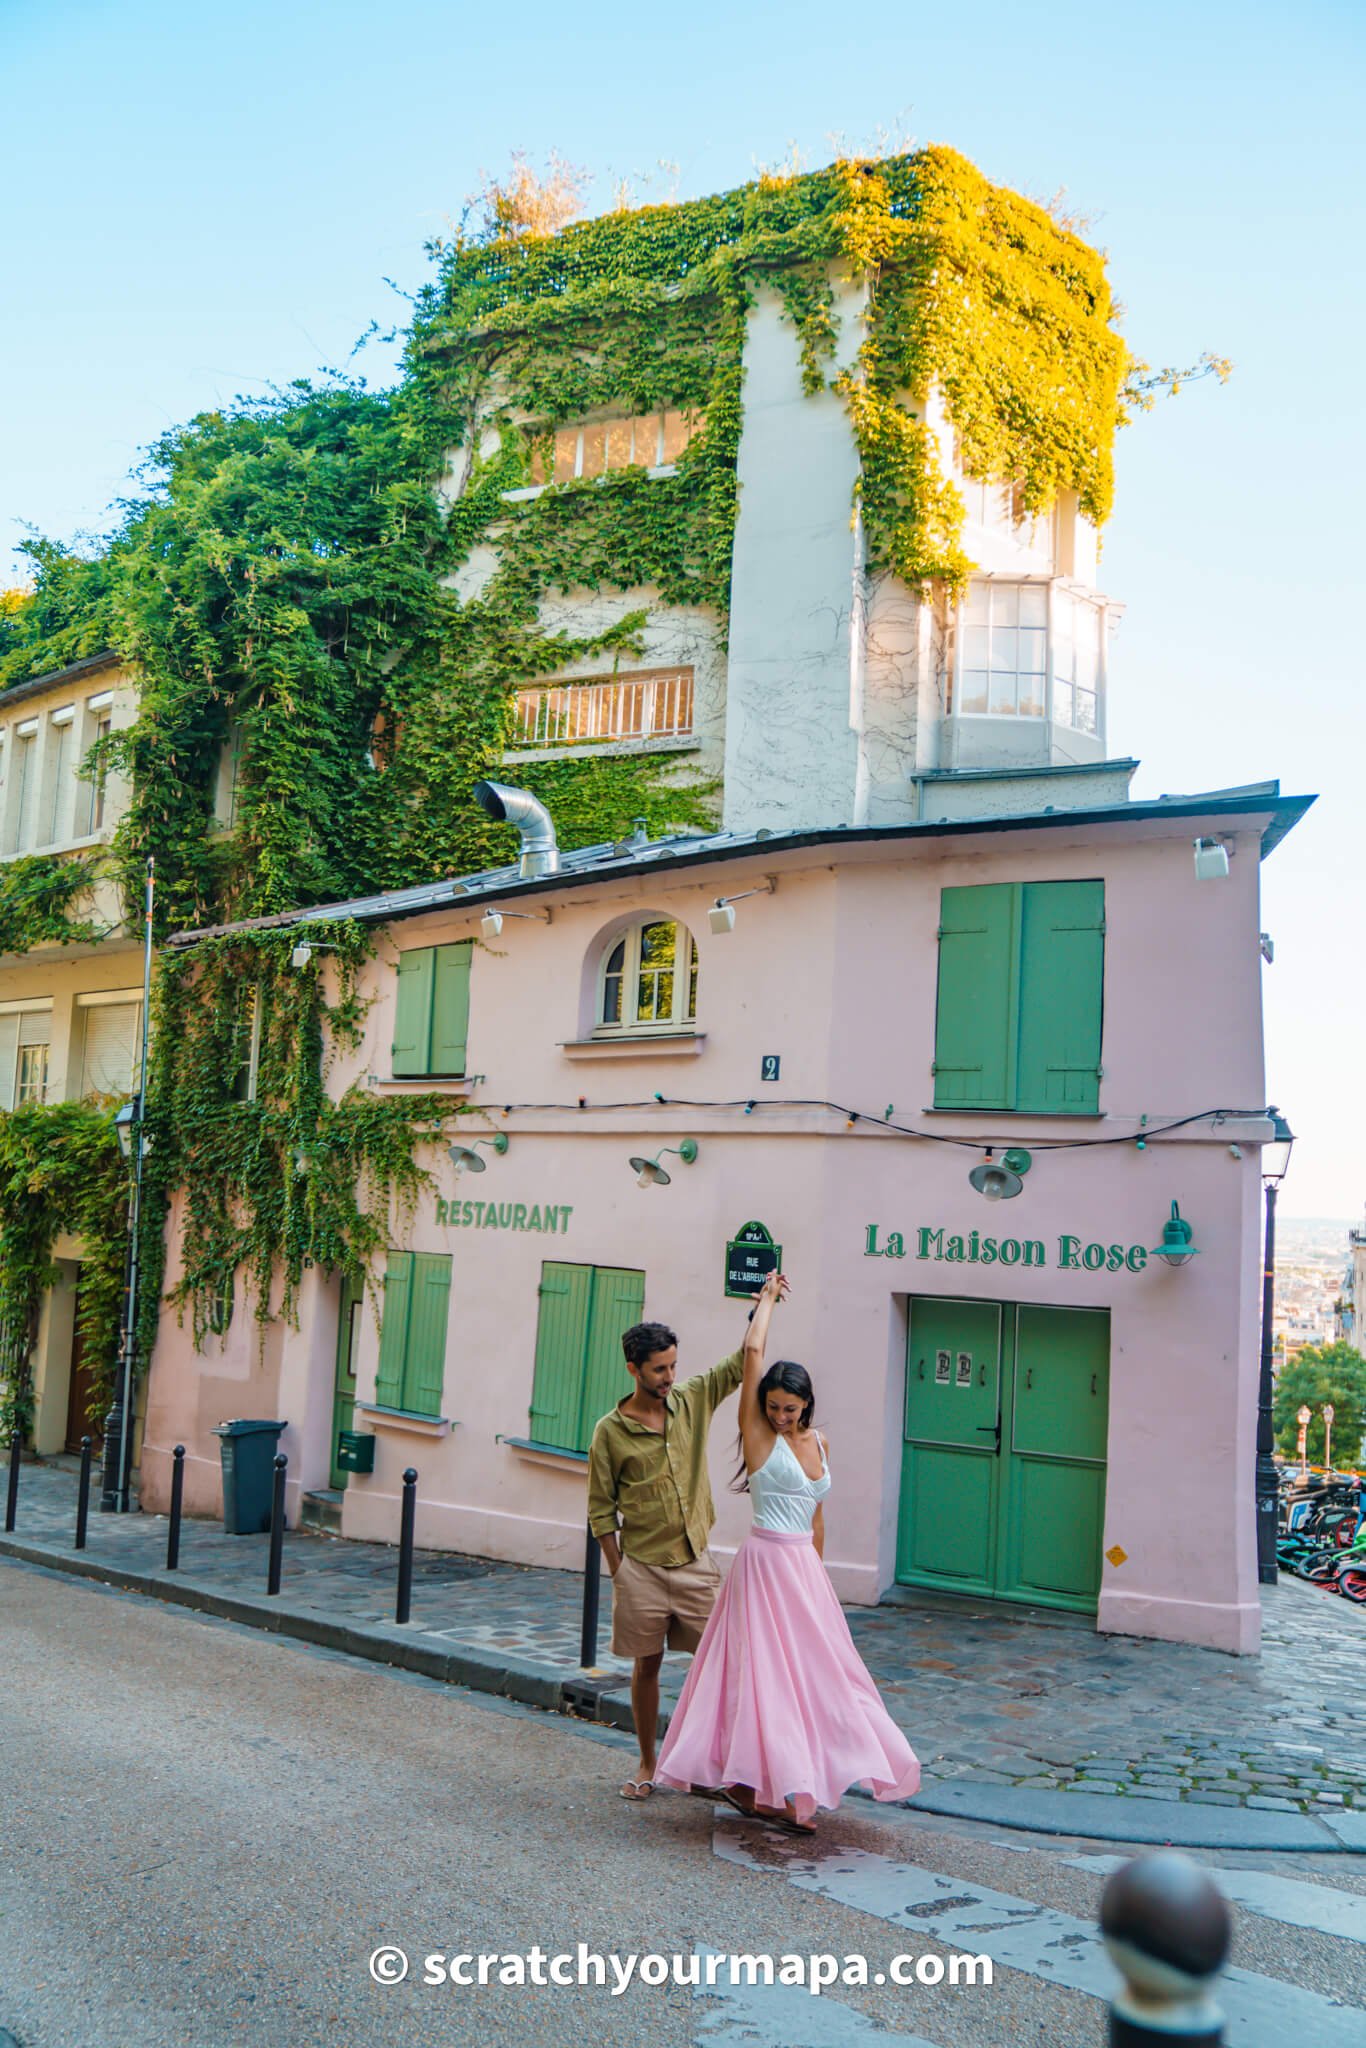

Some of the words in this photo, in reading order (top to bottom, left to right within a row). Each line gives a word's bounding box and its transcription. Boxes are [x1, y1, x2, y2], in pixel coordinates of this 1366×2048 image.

[765, 1057, 776, 1079] 2
[434, 1199, 574, 1234] RESTAURANT
[864, 1224, 906, 1258] La
[916, 1226, 1046, 1268] Maison
[1056, 1234, 1148, 1272] Rose
[746, 1256, 759, 1267] RUE
[729, 1270, 737, 1281] DE
